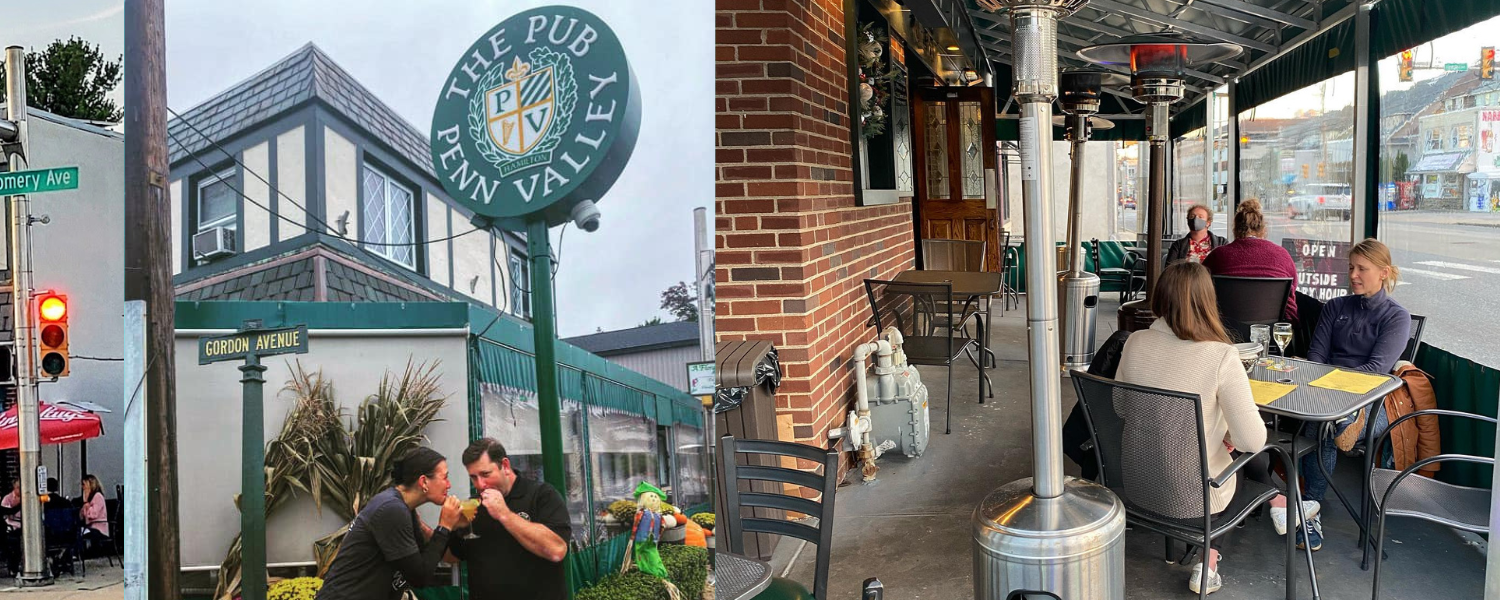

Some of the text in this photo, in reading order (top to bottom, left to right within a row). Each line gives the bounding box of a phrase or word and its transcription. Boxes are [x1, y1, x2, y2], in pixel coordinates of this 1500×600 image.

[446, 14, 598, 100] THE PUB
[494, 90, 511, 114] P
[525, 107, 550, 134] V
[437, 71, 618, 205] PENN VALLEY
[503, 154, 548, 173] HAMILTON
[46, 170, 71, 186] Ave
[1302, 244, 1336, 258] OPEN
[1297, 272, 1338, 286] UTSIDE
[205, 331, 300, 357] GORDON AVENUE
